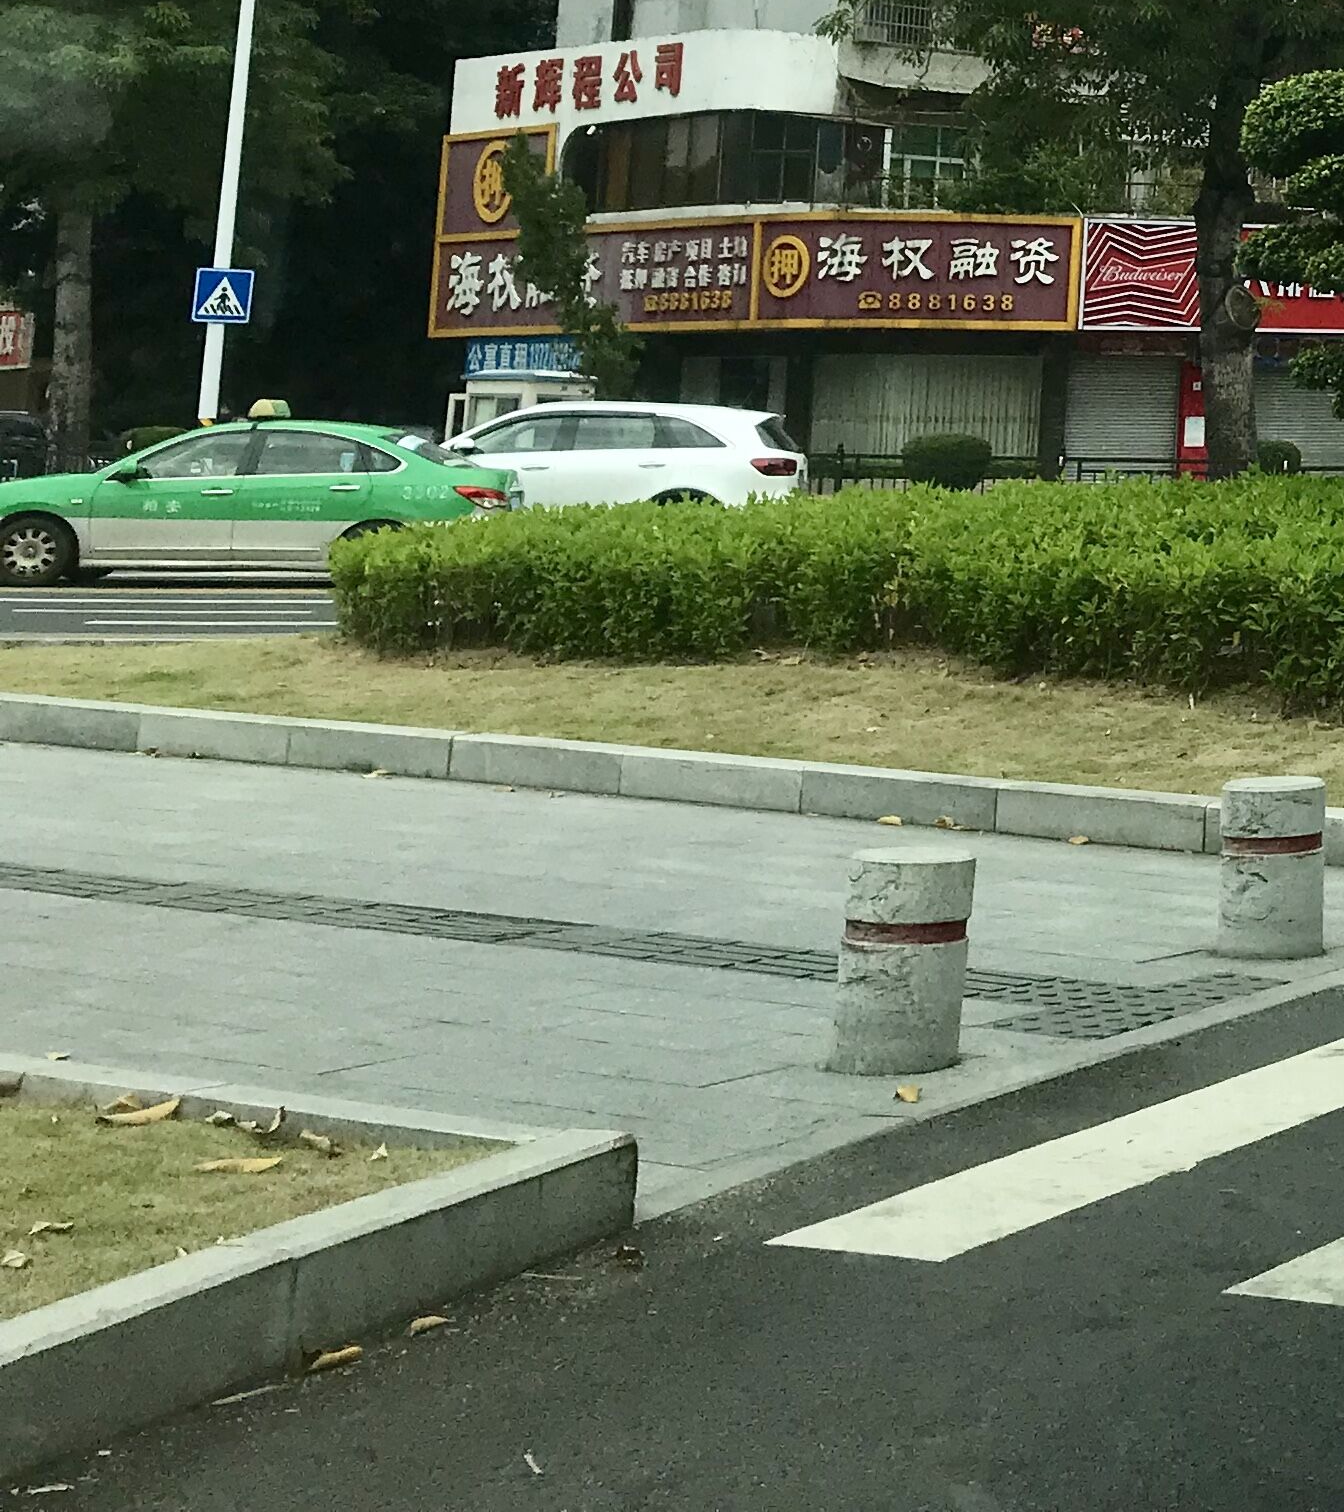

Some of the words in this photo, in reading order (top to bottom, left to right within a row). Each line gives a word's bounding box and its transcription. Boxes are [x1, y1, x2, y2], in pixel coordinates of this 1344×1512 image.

[494, 42, 684, 119] 新辉程公司
[816, 232, 1059, 285] 海权融资
[1100, 265, 1185, 282] Budweiser
[888, 291, 1014, 311] 8881638
